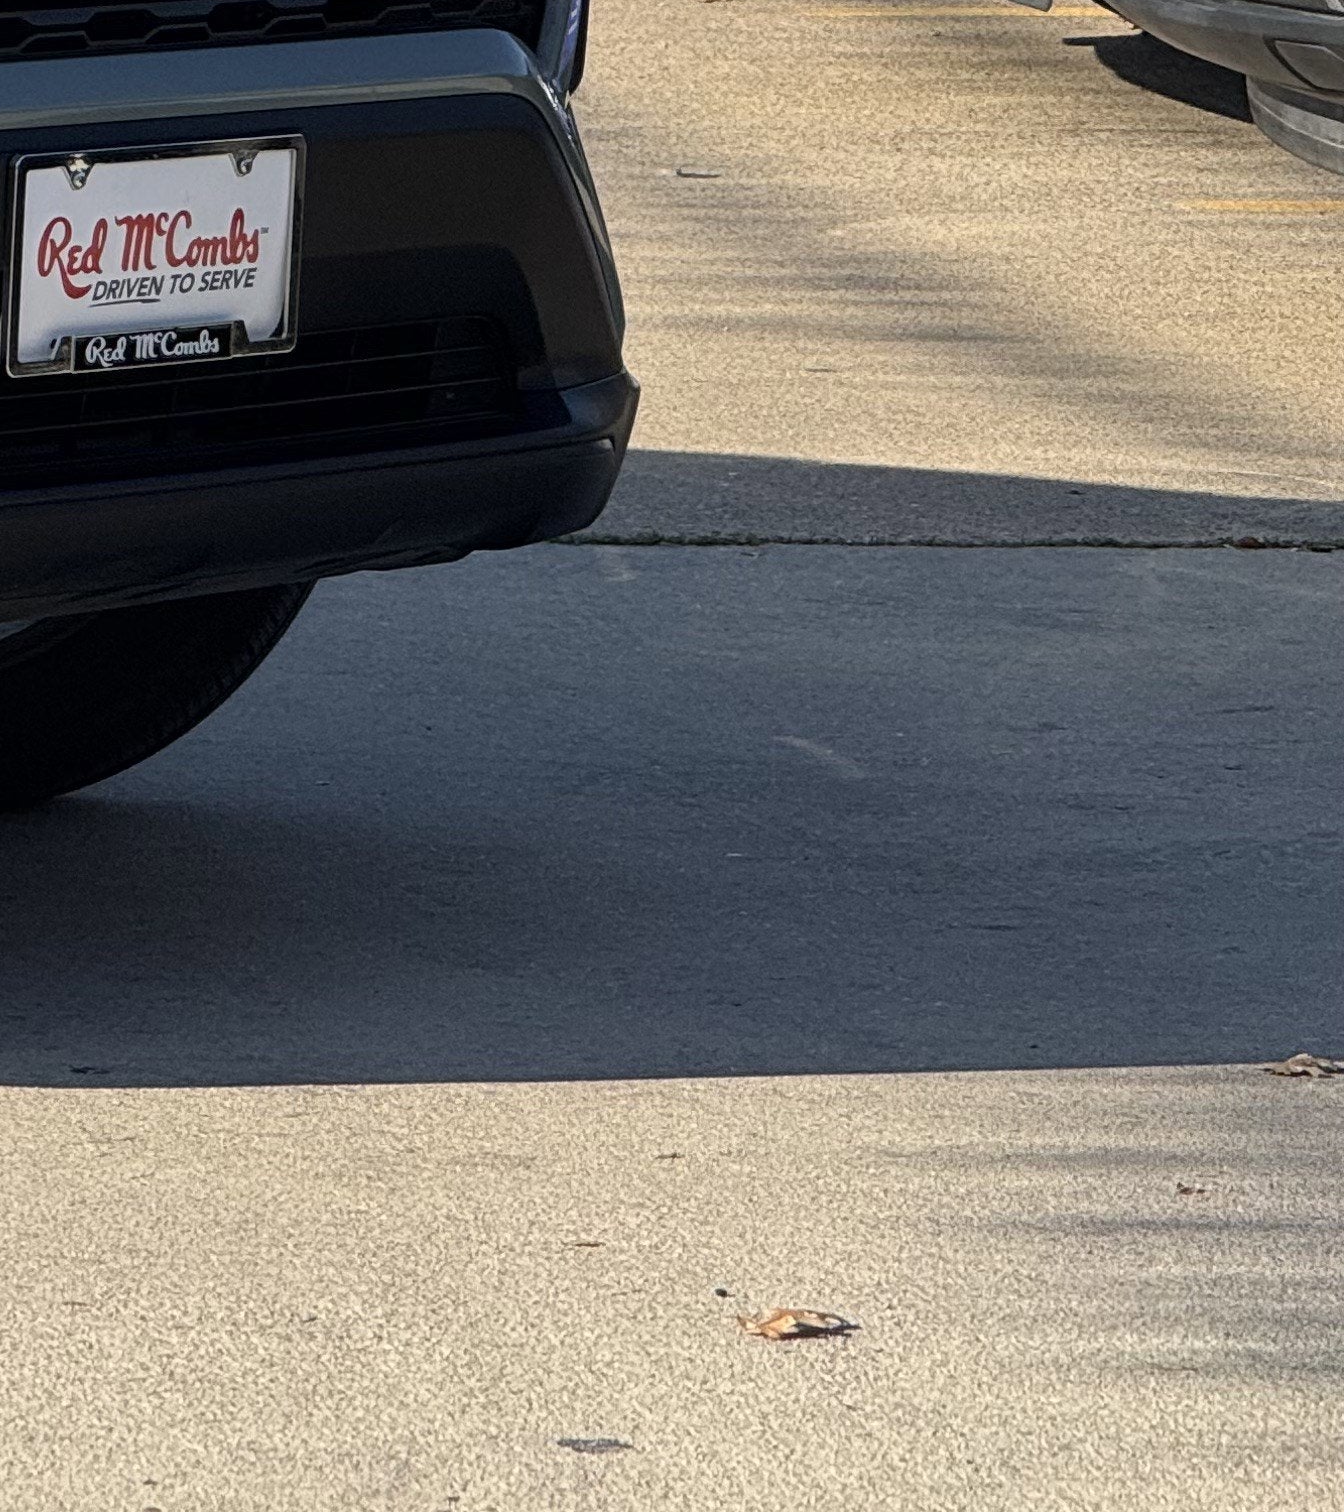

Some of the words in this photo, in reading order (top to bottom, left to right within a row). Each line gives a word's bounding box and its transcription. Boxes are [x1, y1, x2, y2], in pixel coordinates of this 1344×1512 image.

[37, 216, 108, 299] Red
[115, 208, 260, 272] McCombs
[92, 276, 165, 300] DRIVEN
[169, 272, 196, 295] TO
[199, 267, 258, 291] SERVE
[85, 336, 127, 368] Red
[129, 328, 220, 359] McCombs
